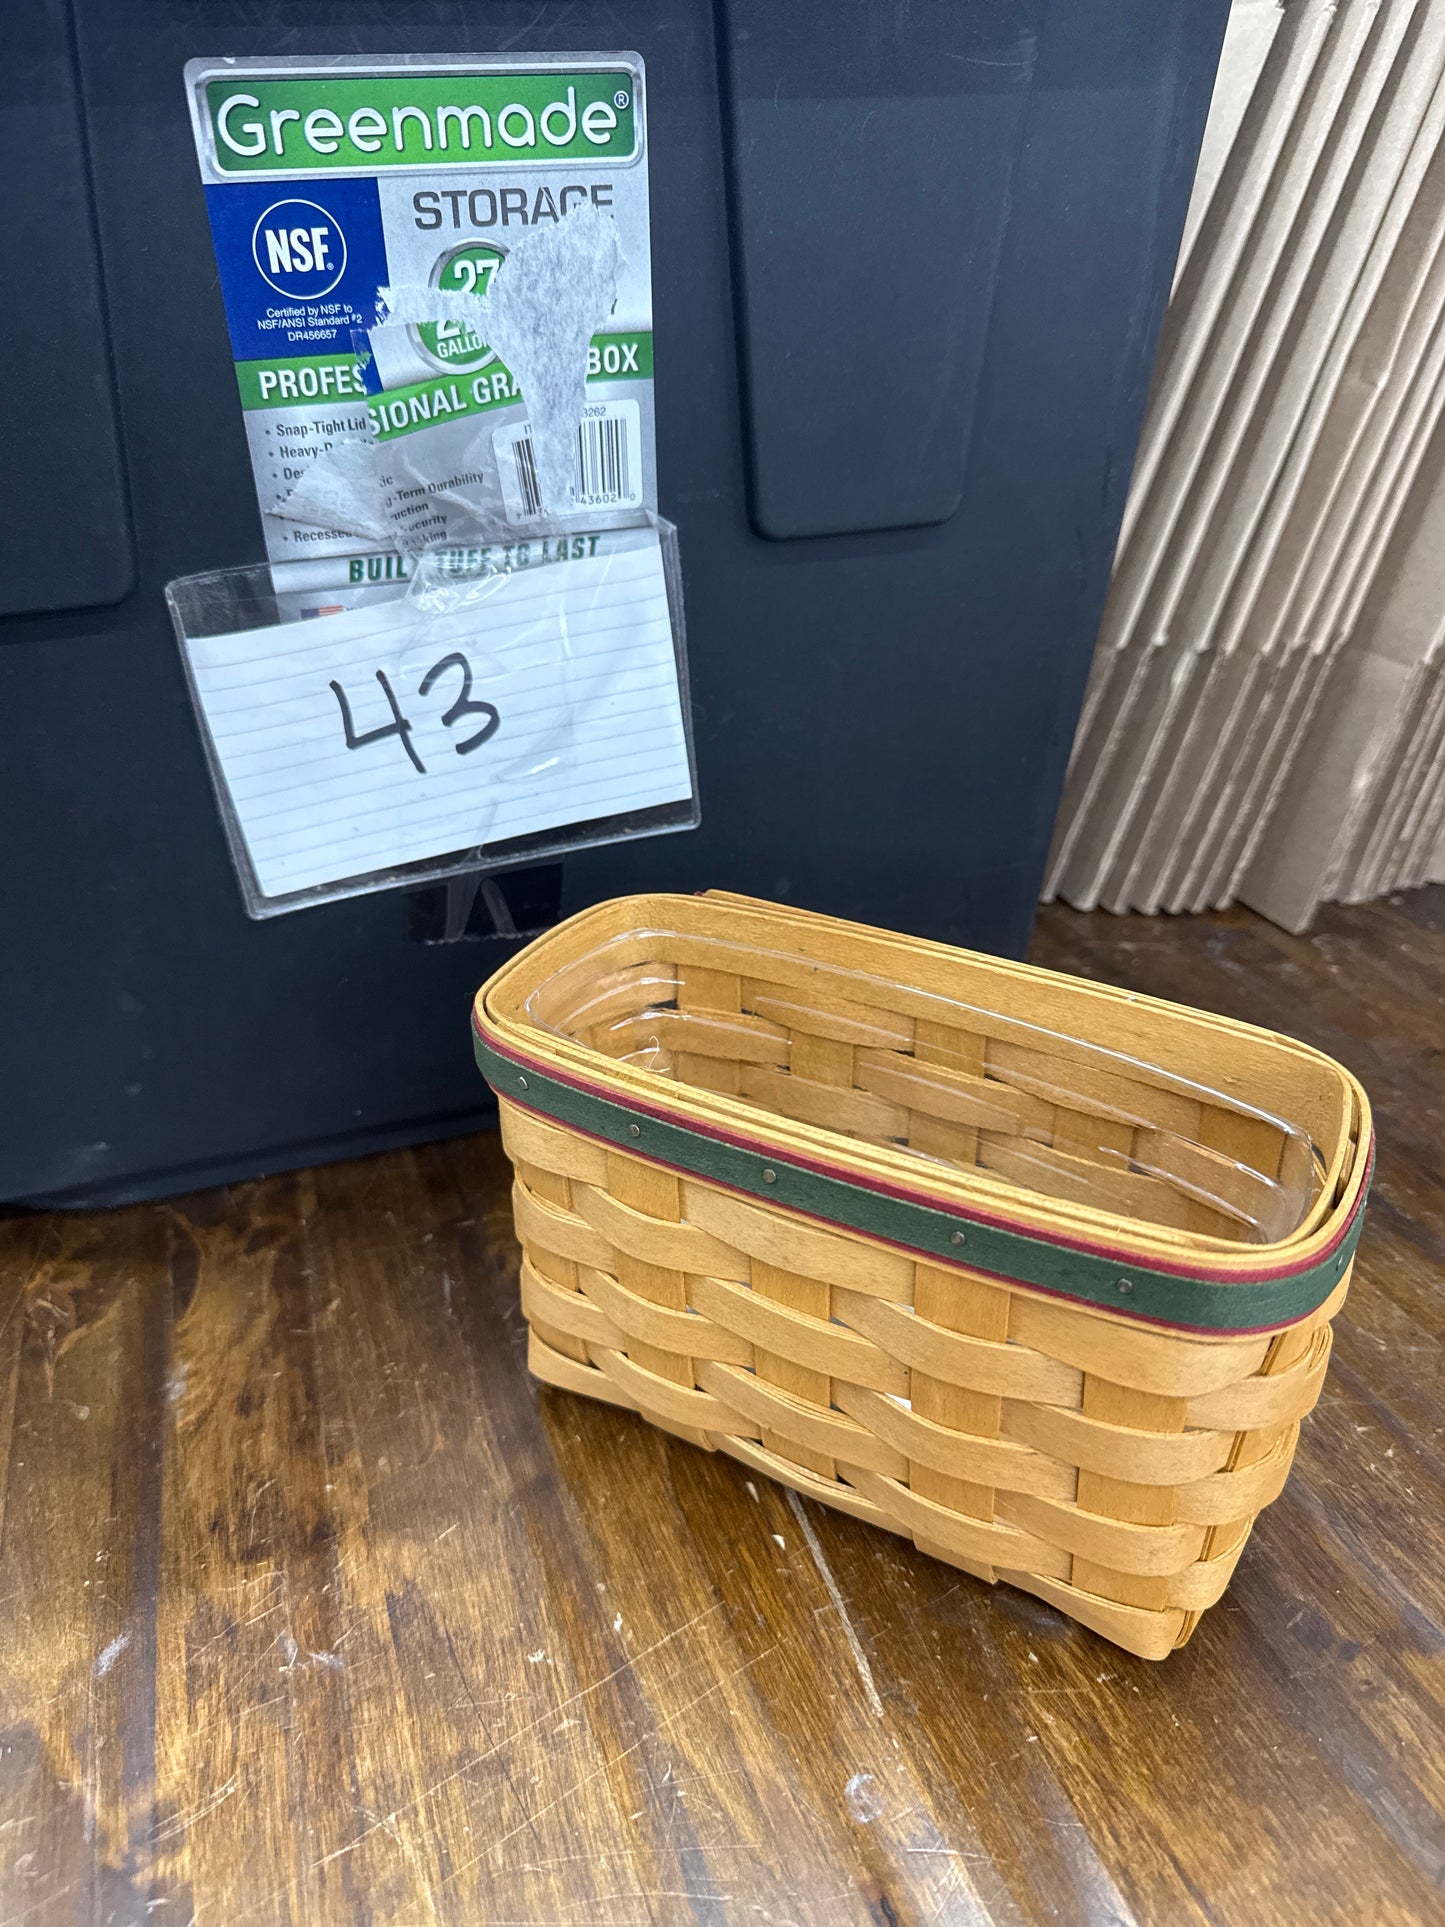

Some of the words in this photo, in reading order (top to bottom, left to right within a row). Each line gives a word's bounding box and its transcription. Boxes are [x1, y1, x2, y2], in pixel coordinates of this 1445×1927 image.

[266, 306, 306, 318] Certified
[307, 305, 319, 318] by
[320, 303, 341, 316] NSF
[343, 303, 354, 315] to
[257, 316, 306, 331] NSF/ANSI
[307, 314, 350, 328] Standard
[287, 328, 338, 342] DR456657
[586, 343, 639, 375] BOX
[276, 419, 346, 439] Snap-Tight
[347, 417, 367, 431] Lid
[427, 472, 484, 495] Durability
[580, 493, 617, 505] 43602
[349, 556, 407, 583] BUIL
[543, 535, 600, 564] LAST
[330, 652, 500, 774] 43
